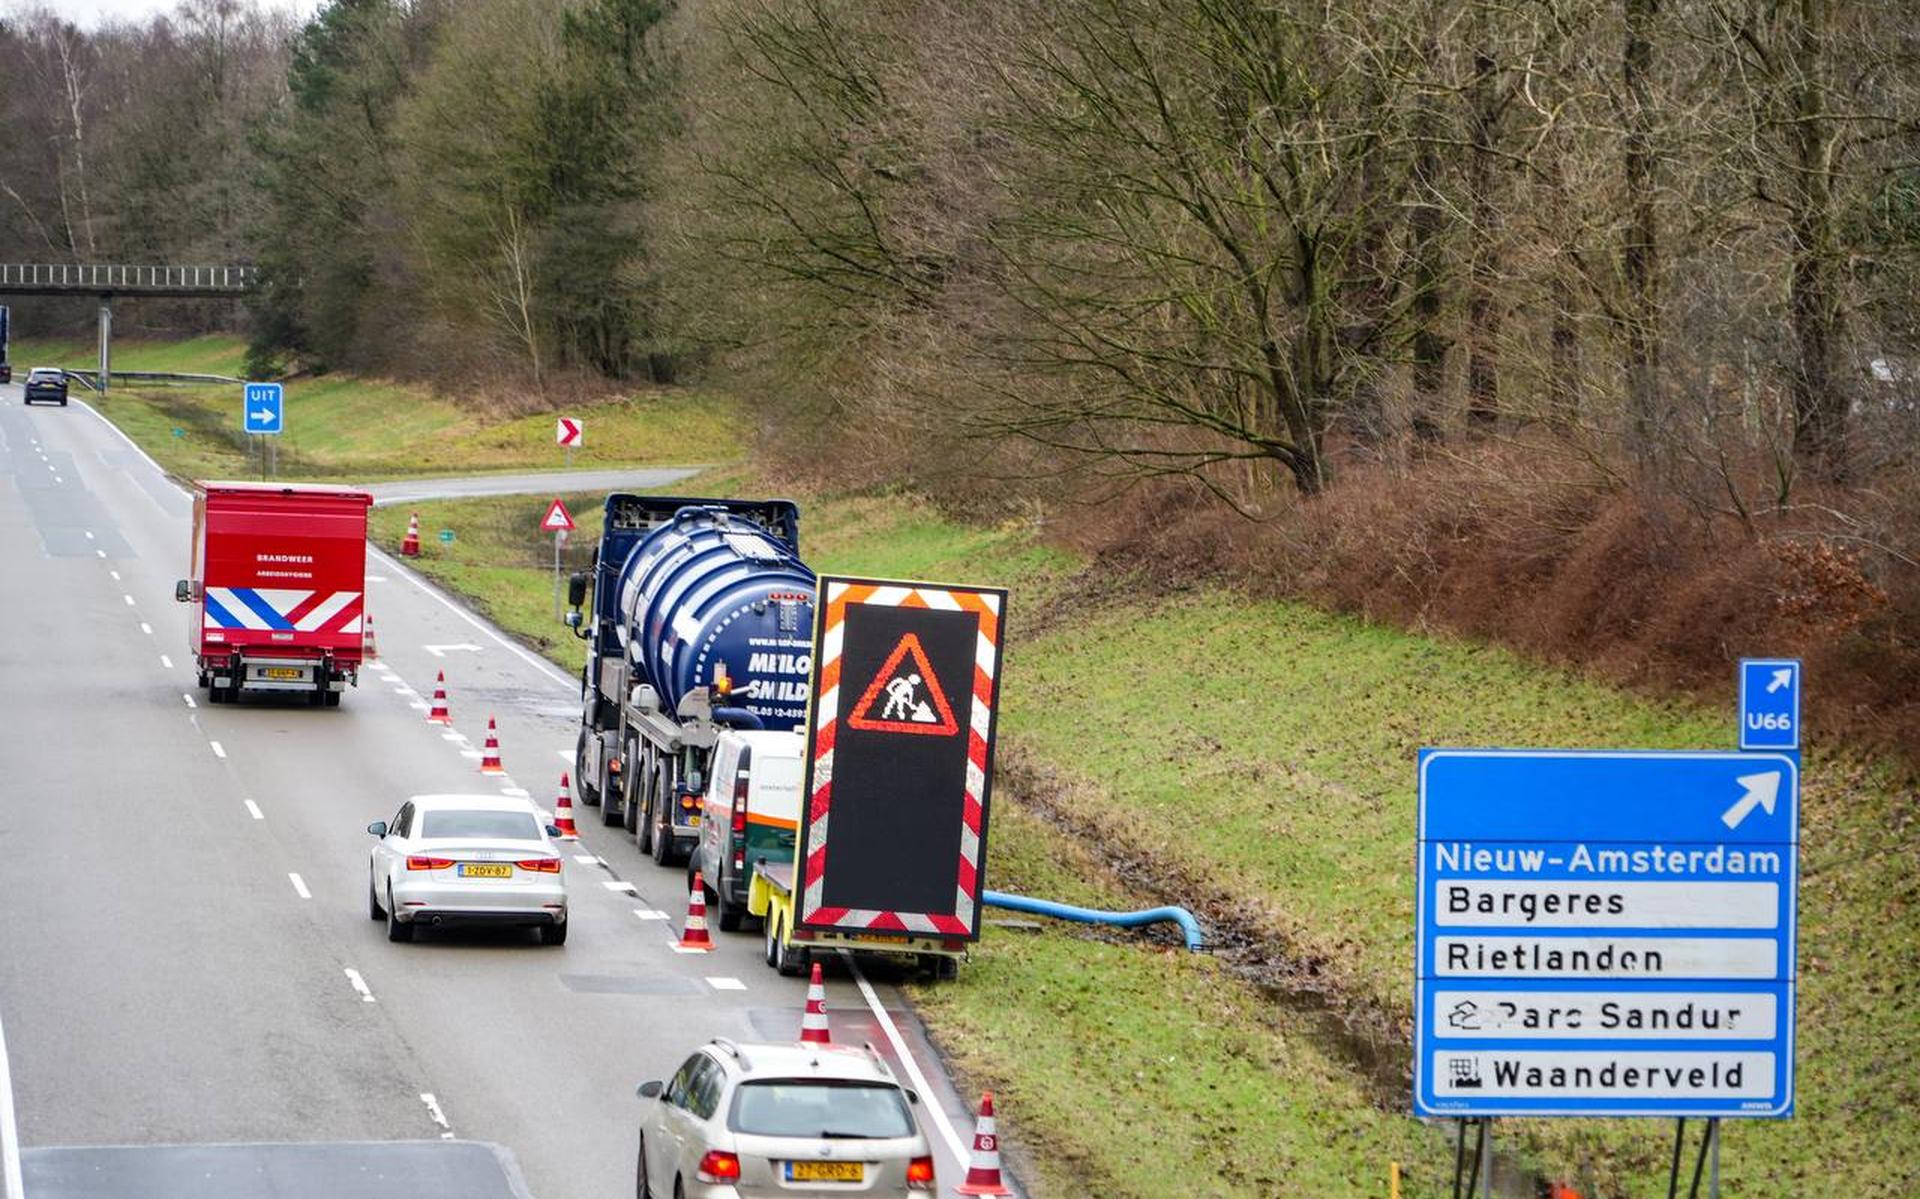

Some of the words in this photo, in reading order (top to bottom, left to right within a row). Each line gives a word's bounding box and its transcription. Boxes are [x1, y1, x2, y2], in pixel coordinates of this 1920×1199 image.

[251, 389, 276, 401] UIT
[257, 554, 313, 563] BRANDWEER
[748, 653, 812, 674] MEILO
[746, 679, 809, 701] SMILD
[1747, 712, 1791, 730] U66
[1435, 843, 1780, 874] Nieuw-Amsterdam
[1448, 886, 1625, 922] Bargeres
[1448, 943, 1663, 972] Rietlanden
[1600, 1002, 1742, 1030] Sandur
[1494, 1060, 1743, 1088] Waanderveld
